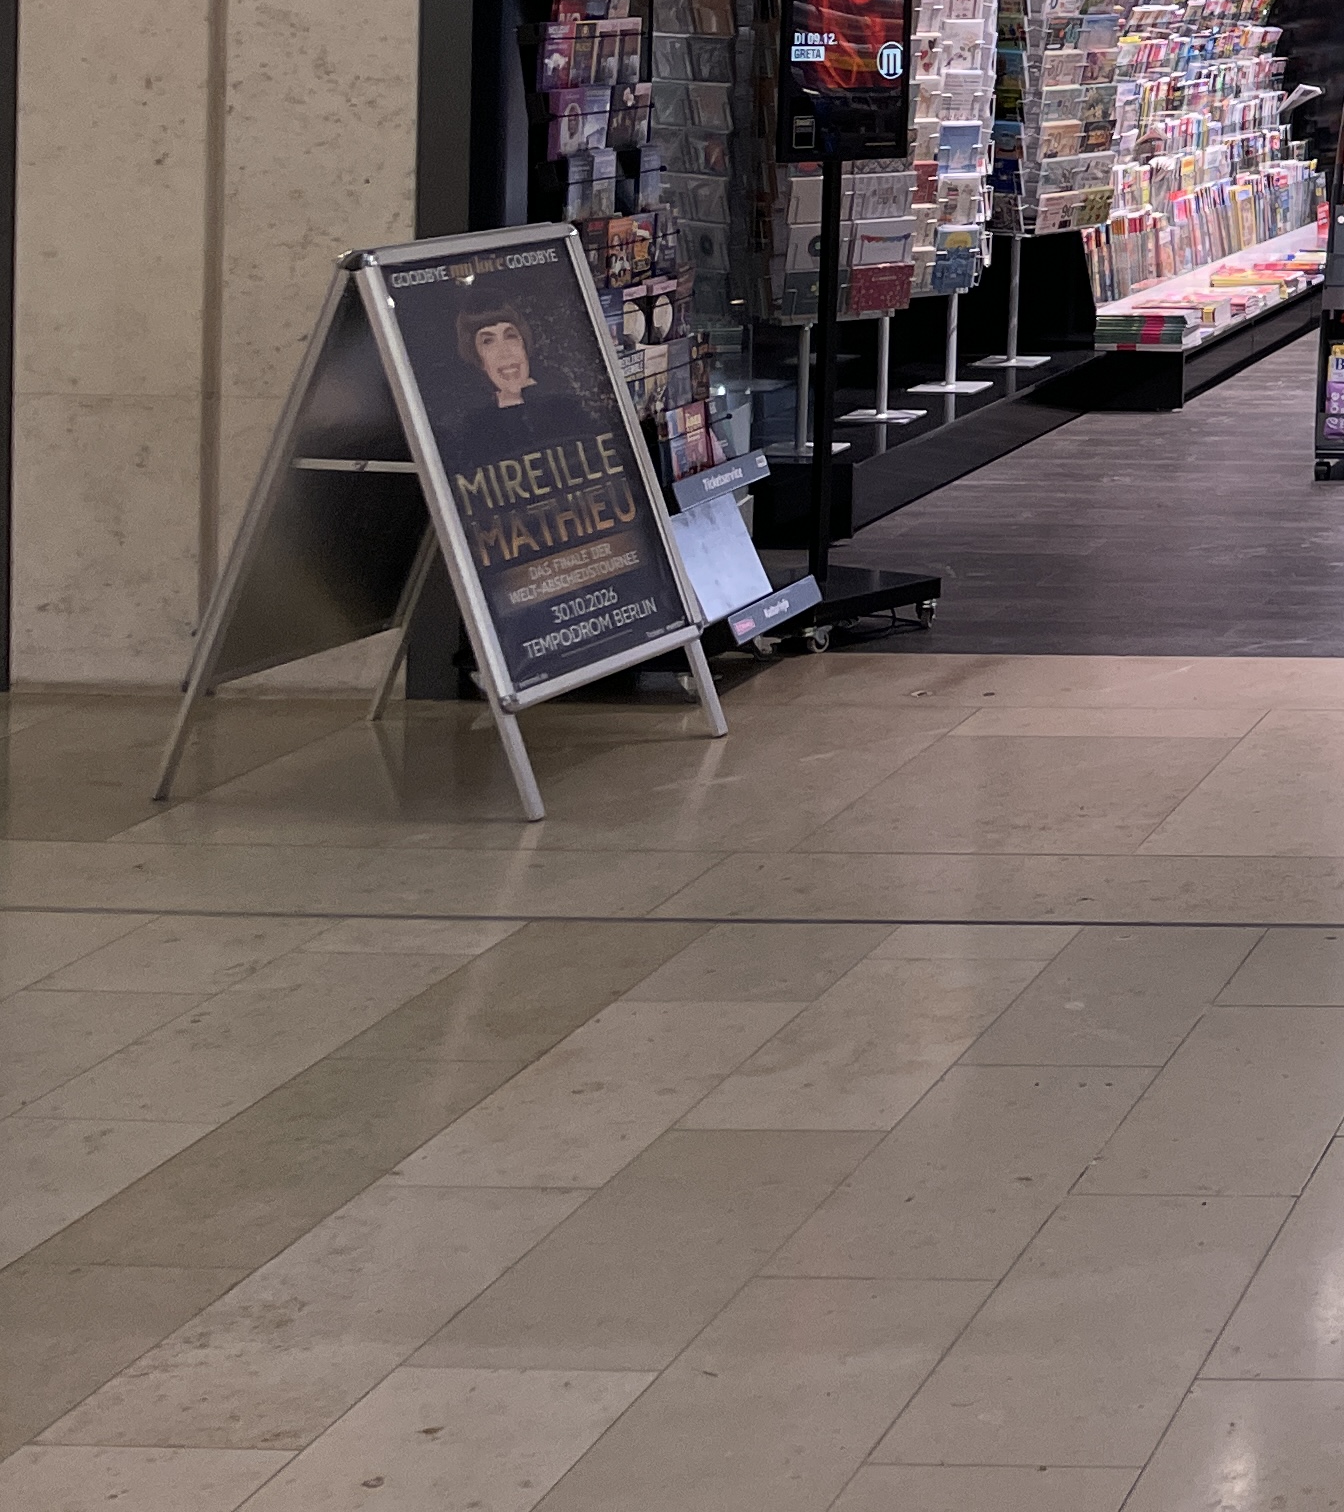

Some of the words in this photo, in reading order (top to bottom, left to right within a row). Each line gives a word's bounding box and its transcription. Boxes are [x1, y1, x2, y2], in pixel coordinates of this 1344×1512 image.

[793, 32, 806, 45] DI
[807, 32, 838, 46] 09.12.
[793, 48, 822, 60] GRETA
[390, 266, 450, 289] GOODBYE
[505, 248, 559, 270] GOODBYE
[455, 432, 624, 516] MIREILLE
[702, 466, 744, 491] Ticketservice
[470, 477, 637, 567] MATHIEU
[528, 561, 552, 581] DAS
[553, 551, 591, 574] FINALE
[592, 543, 612, 561] DER
[551, 586, 619, 624] 30.10.2026
[523, 614, 614, 659] TEMPODROM
[614, 597, 658, 627] BERLIN
